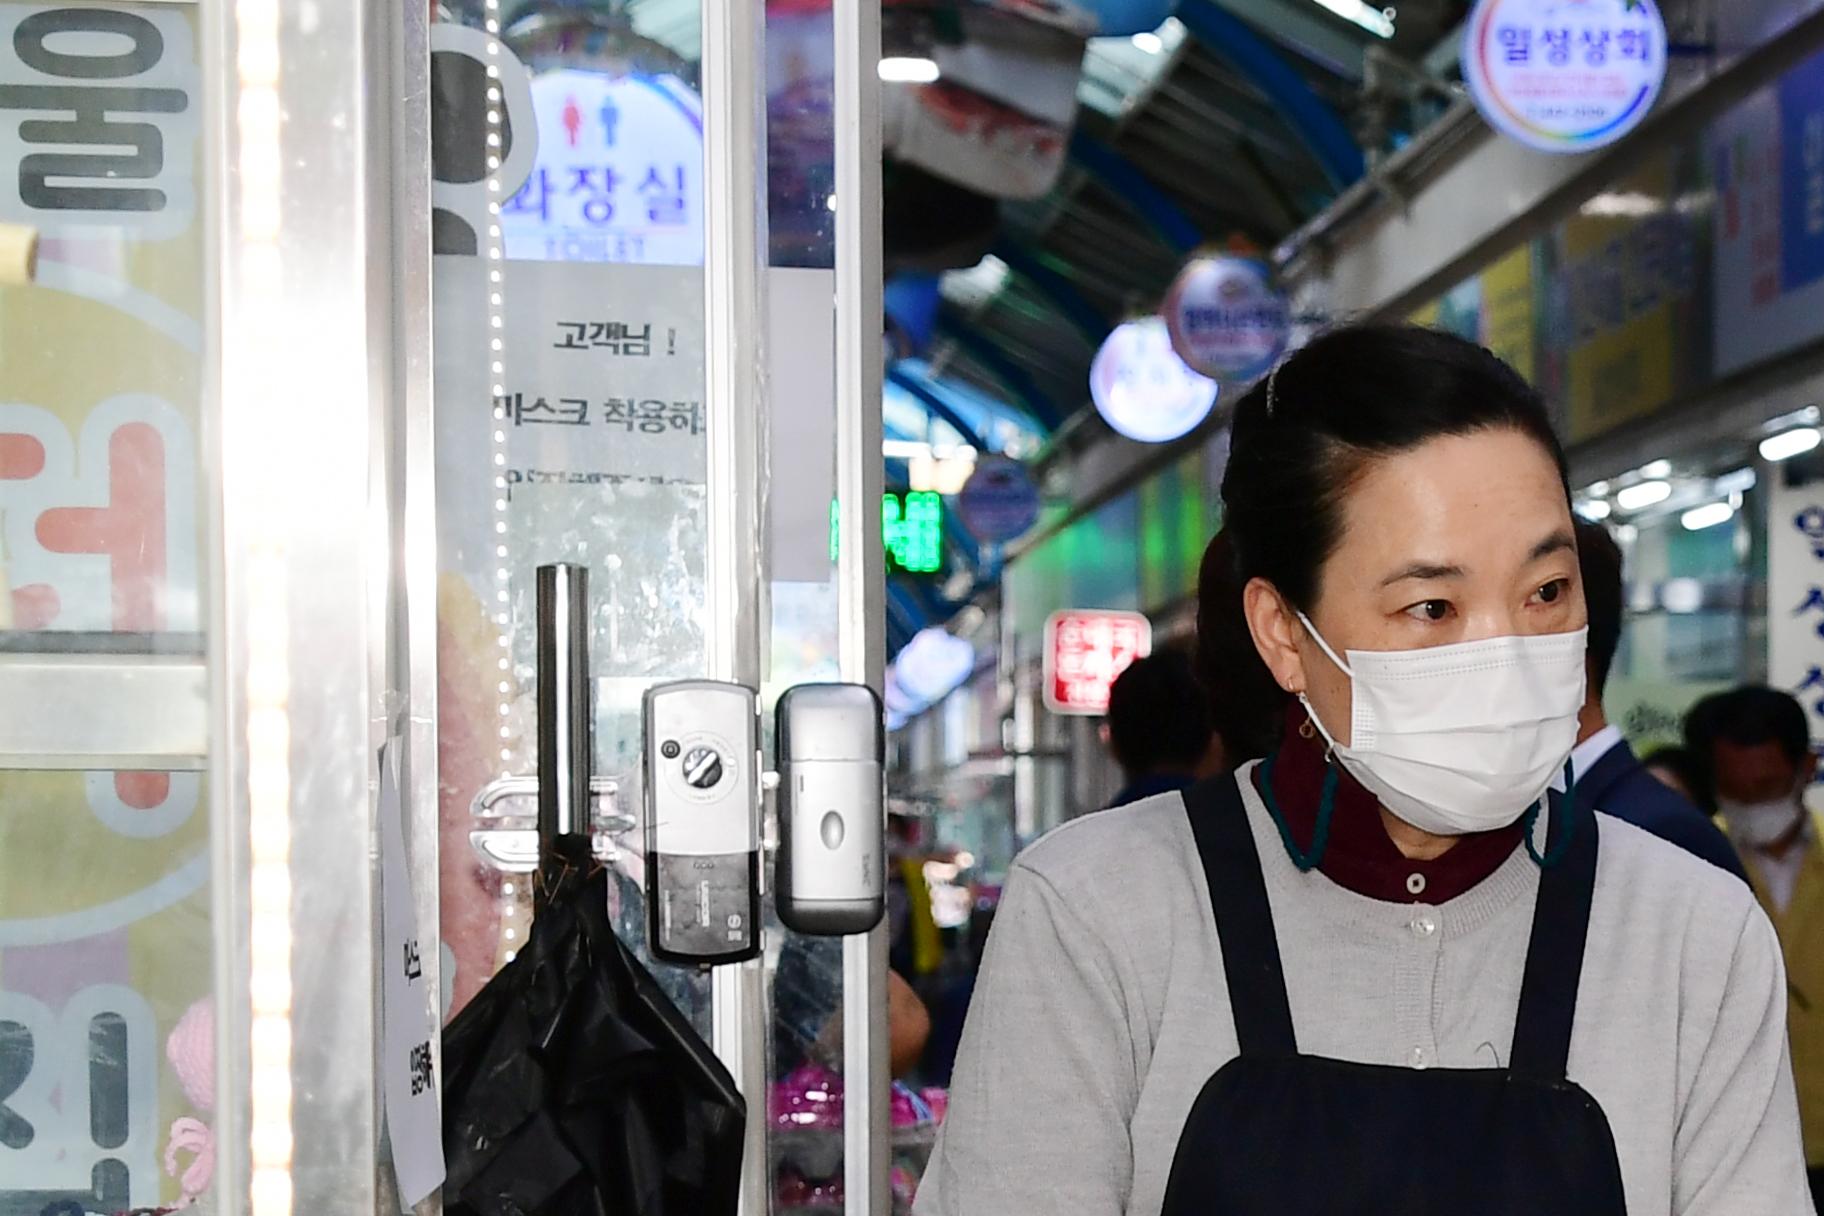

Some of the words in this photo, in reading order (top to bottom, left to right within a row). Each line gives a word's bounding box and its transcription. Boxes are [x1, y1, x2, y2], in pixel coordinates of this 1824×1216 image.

[1499, 27, 1650, 64] 일성상회
[553, 322, 650, 357] 고객님
[603, 398, 706, 435] 착용하
